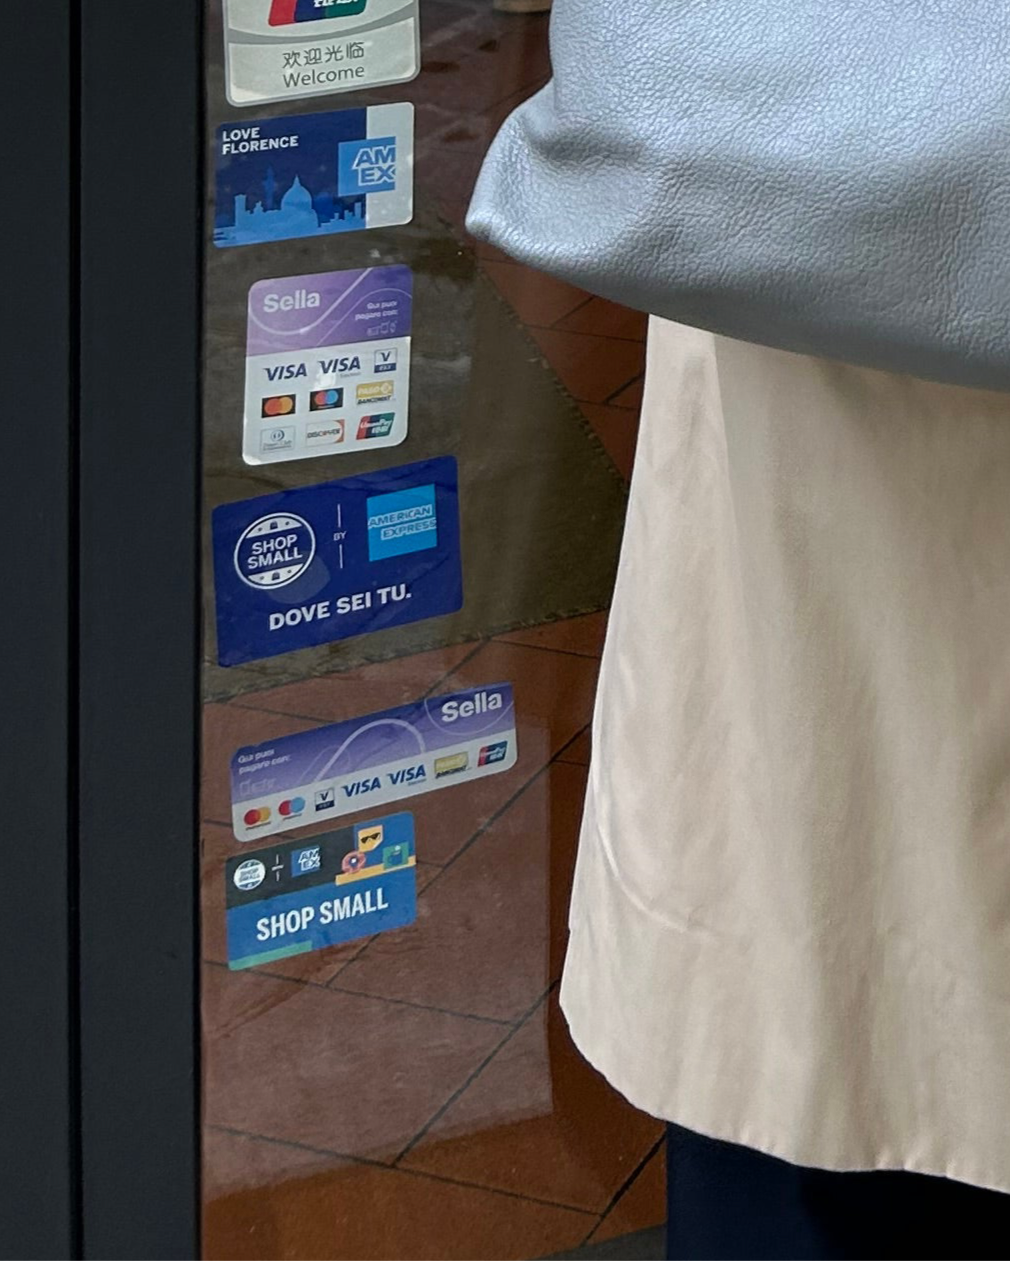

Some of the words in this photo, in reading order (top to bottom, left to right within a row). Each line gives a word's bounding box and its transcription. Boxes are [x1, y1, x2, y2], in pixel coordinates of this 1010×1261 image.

[282, 41, 365, 69] 欢迎光临
[282, 66, 365, 88] Welcome
[222, 127, 260, 142] LOVE
[222, 136, 299, 155] FLORENCE
[264, 291, 319, 312] Sella
[264, 363, 307, 380] VISA
[317, 356, 361, 374] VISA
[380, 351, 392, 362] V
[367, 504, 433, 530] AMERICAN
[333, 531, 346, 541] BY
[381, 519, 436, 541] EXPRESS
[251, 534, 297, 555] SHOP
[247, 546, 303, 570] SMALL
[269, 601, 331, 630] DOVE
[336, 594, 371, 614] SEI
[376, 583, 412, 605] TU.
[441, 691, 503, 722] Sella
[341, 777, 381, 798] VISA
[386, 764, 426, 785] VISA
[256, 906, 315, 941] SHOP
[319, 887, 389, 924] SMALL
